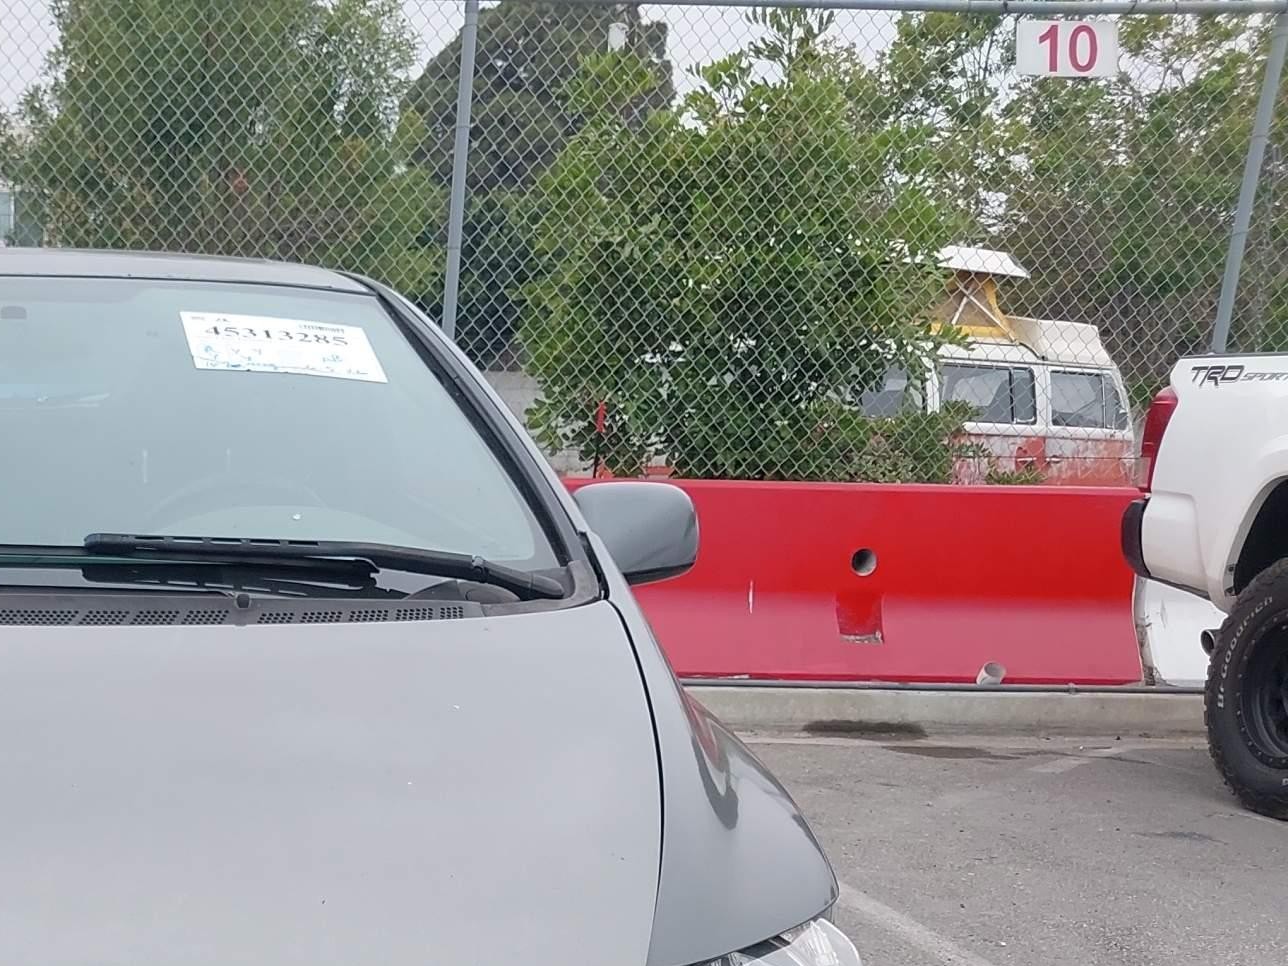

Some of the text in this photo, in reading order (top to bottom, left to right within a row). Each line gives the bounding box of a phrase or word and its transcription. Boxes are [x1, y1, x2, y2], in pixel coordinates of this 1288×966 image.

[1038, 24, 1098, 73] 10
[204, 325, 349, 347] 45313285
[1191, 364, 1244, 387] TRD
